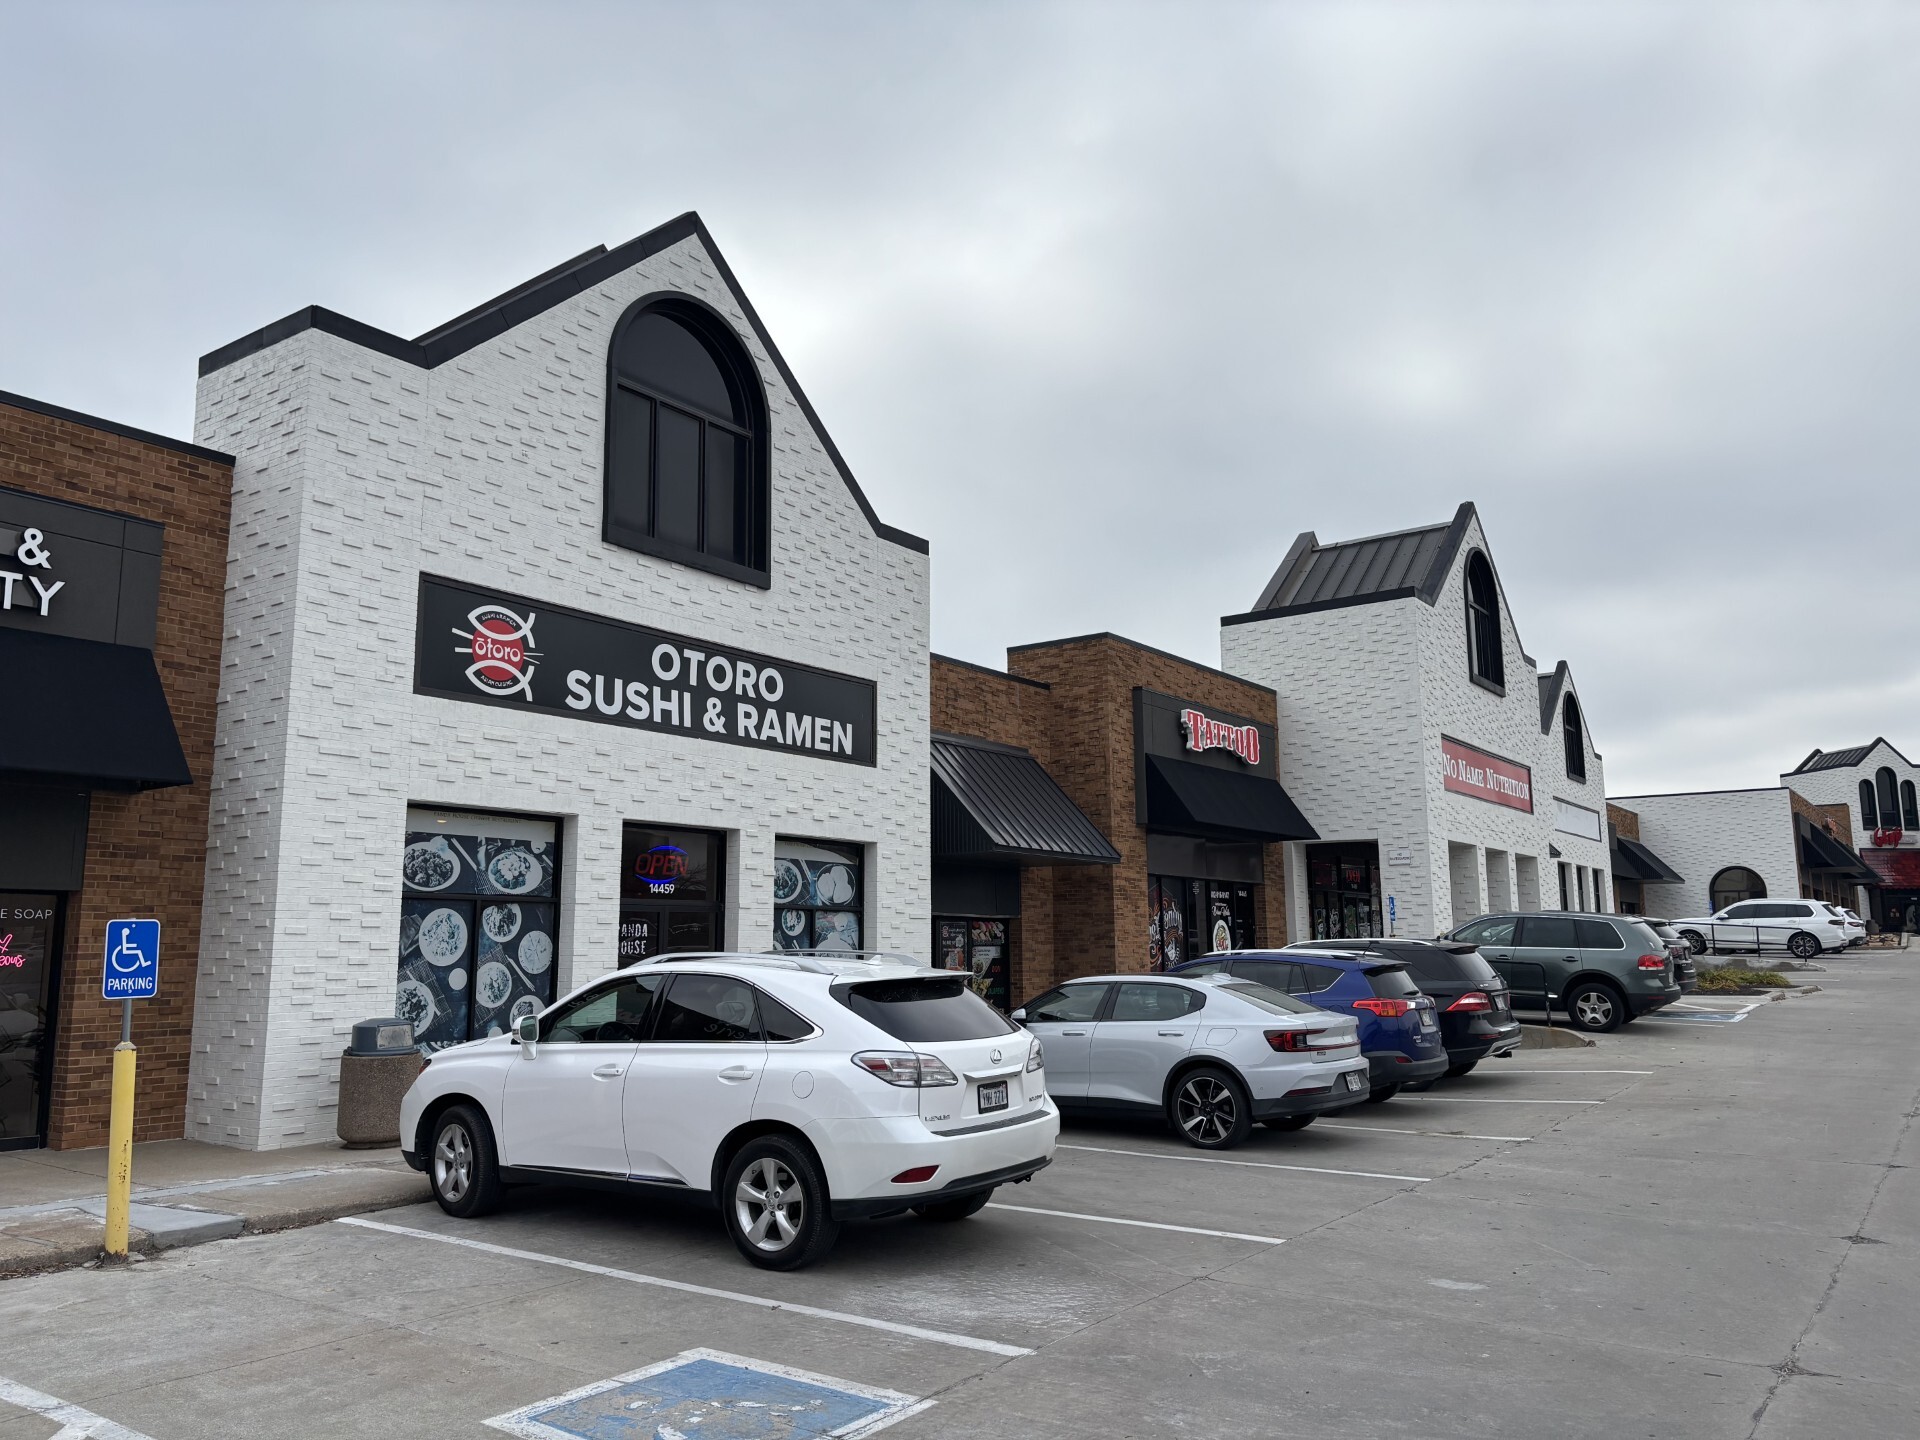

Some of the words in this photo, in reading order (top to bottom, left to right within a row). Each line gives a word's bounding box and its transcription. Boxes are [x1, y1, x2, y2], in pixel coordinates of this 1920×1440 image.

[17, 527, 52, 569] &
[0, 570, 66, 617] TY
[651, 643, 784, 702] OTORO
[564, 669, 692, 728] SUSHI
[702, 696, 727, 735] &
[737, 703, 853, 755] RAMEN
[1181, 708, 1260, 765] TATTOO
[1458, 758, 1485, 788] NAME
[1485, 767, 1530, 801] NUTRITION
[634, 854, 689, 876] OPEN
[649, 883, 675, 894] 14459
[14, 908, 53, 919] SOAP
[620, 923, 648, 937] ANDA
[620, 940, 647, 955] OUSE
[107, 976, 153, 991] PARKING
